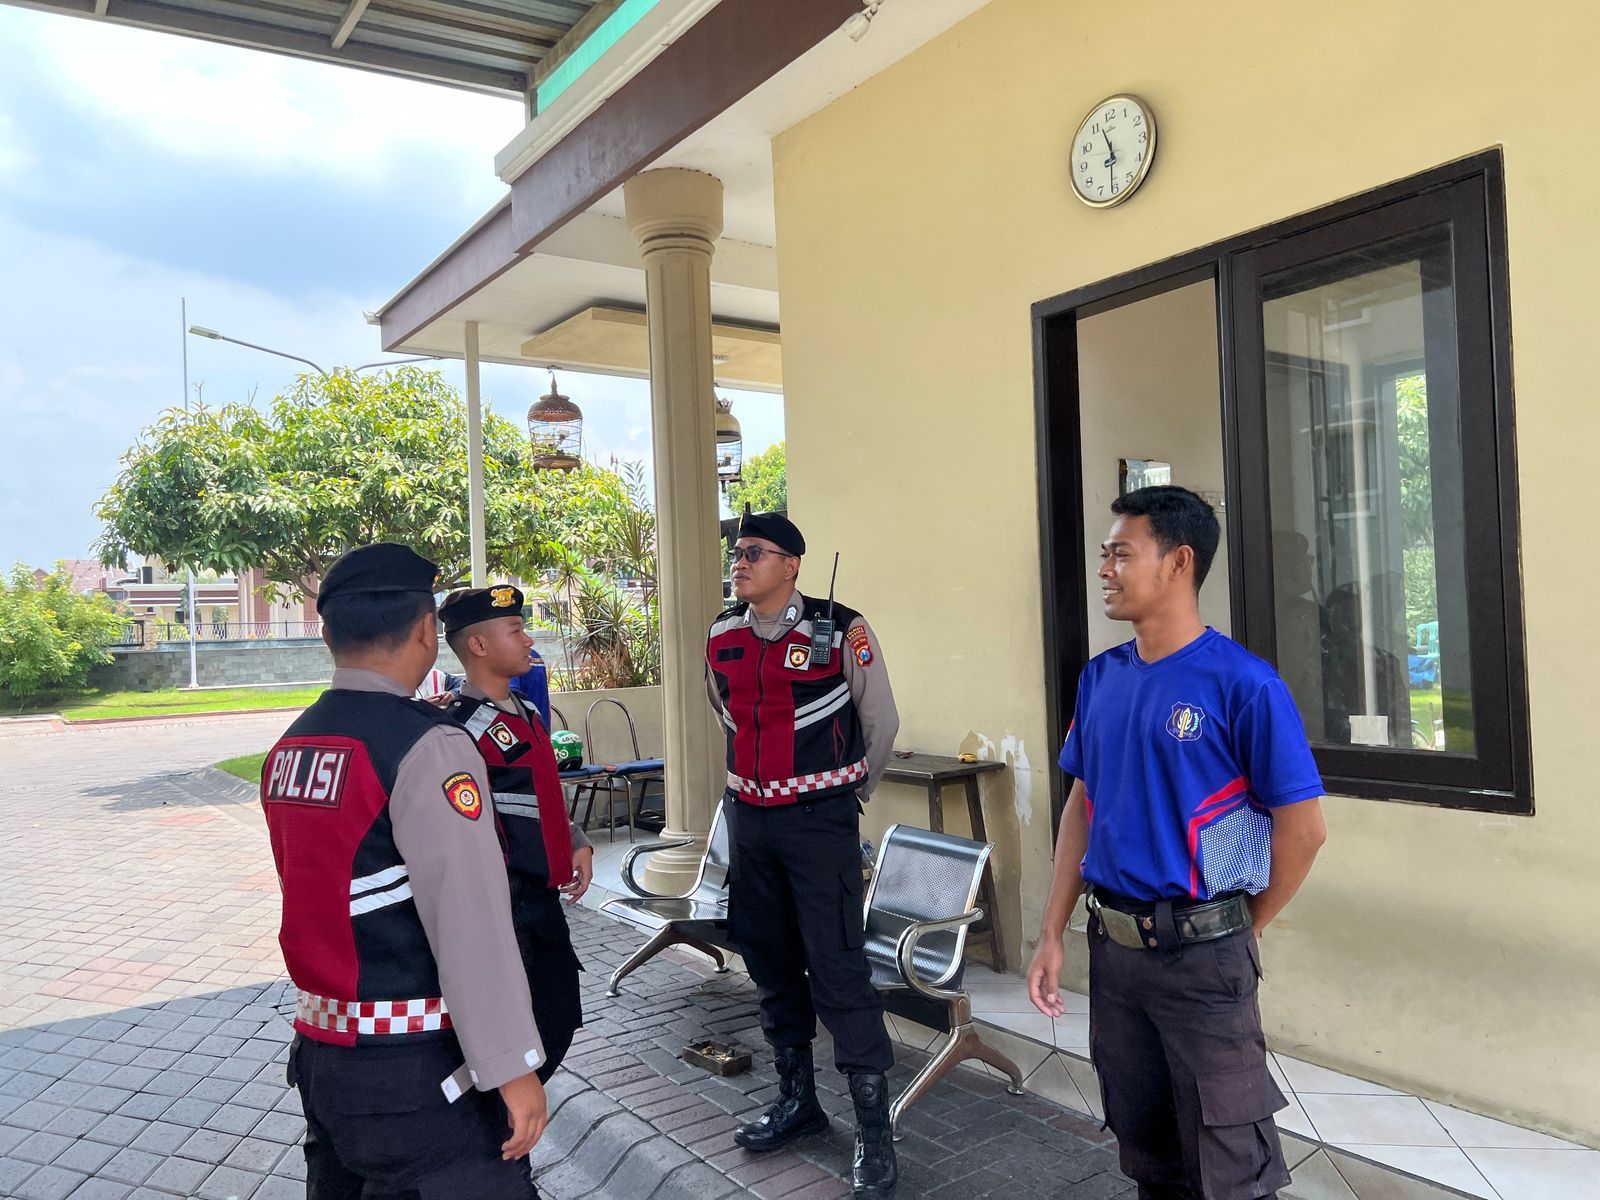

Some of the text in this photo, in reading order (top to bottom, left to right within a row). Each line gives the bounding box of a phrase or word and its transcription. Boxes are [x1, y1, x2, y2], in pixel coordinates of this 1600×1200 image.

[1104, 109, 1115, 123] 12
[1122, 108, 1127, 118] 1
[1133, 115, 1141, 127] 2
[1092, 123, 1100, 135] 11
[1139, 132, 1147, 143] 3
[1083, 142, 1092, 154] 10
[1135, 152, 1142, 162] 4
[1080, 162, 1088, 173] 9
[1086, 177, 1093, 188] 8
[1126, 171, 1134, 183] 5
[1097, 186, 1104, 196] 7
[1112, 183, 1119, 195] 6
[267, 750, 345, 801] POLISI
